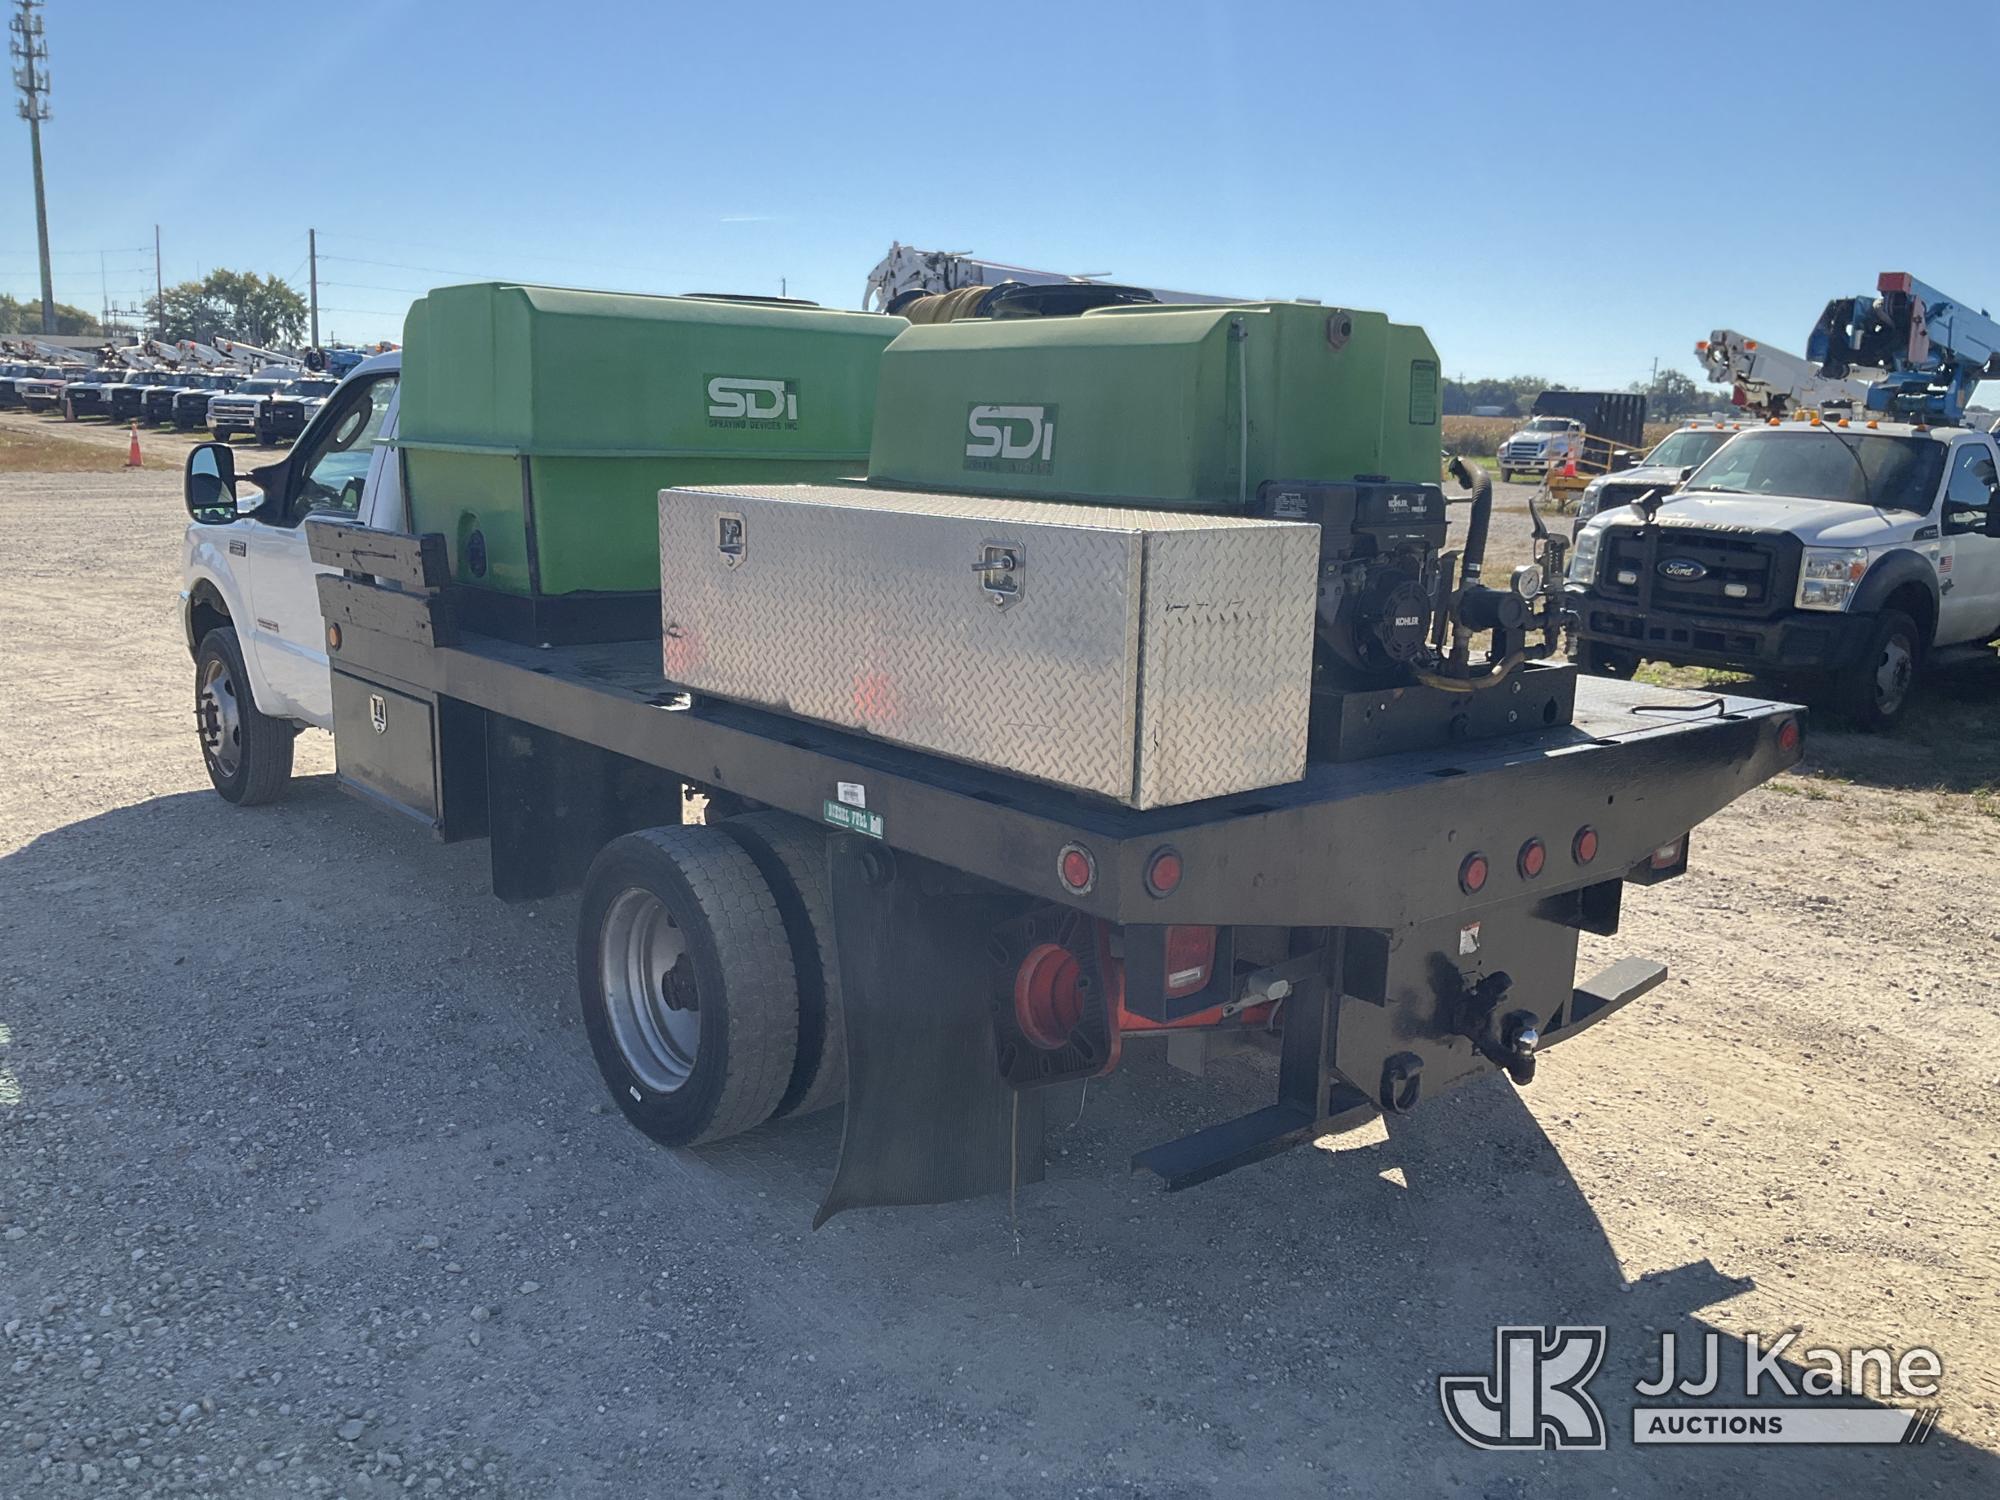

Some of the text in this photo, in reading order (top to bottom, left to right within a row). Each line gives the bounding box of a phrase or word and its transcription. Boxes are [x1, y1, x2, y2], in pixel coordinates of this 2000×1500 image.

[1666, 562, 1694, 577] Ford
[1395, 616, 1419, 626] KOHLER
[828, 803, 850, 822] DIESEL
[851, 811, 868, 829] FUEL
